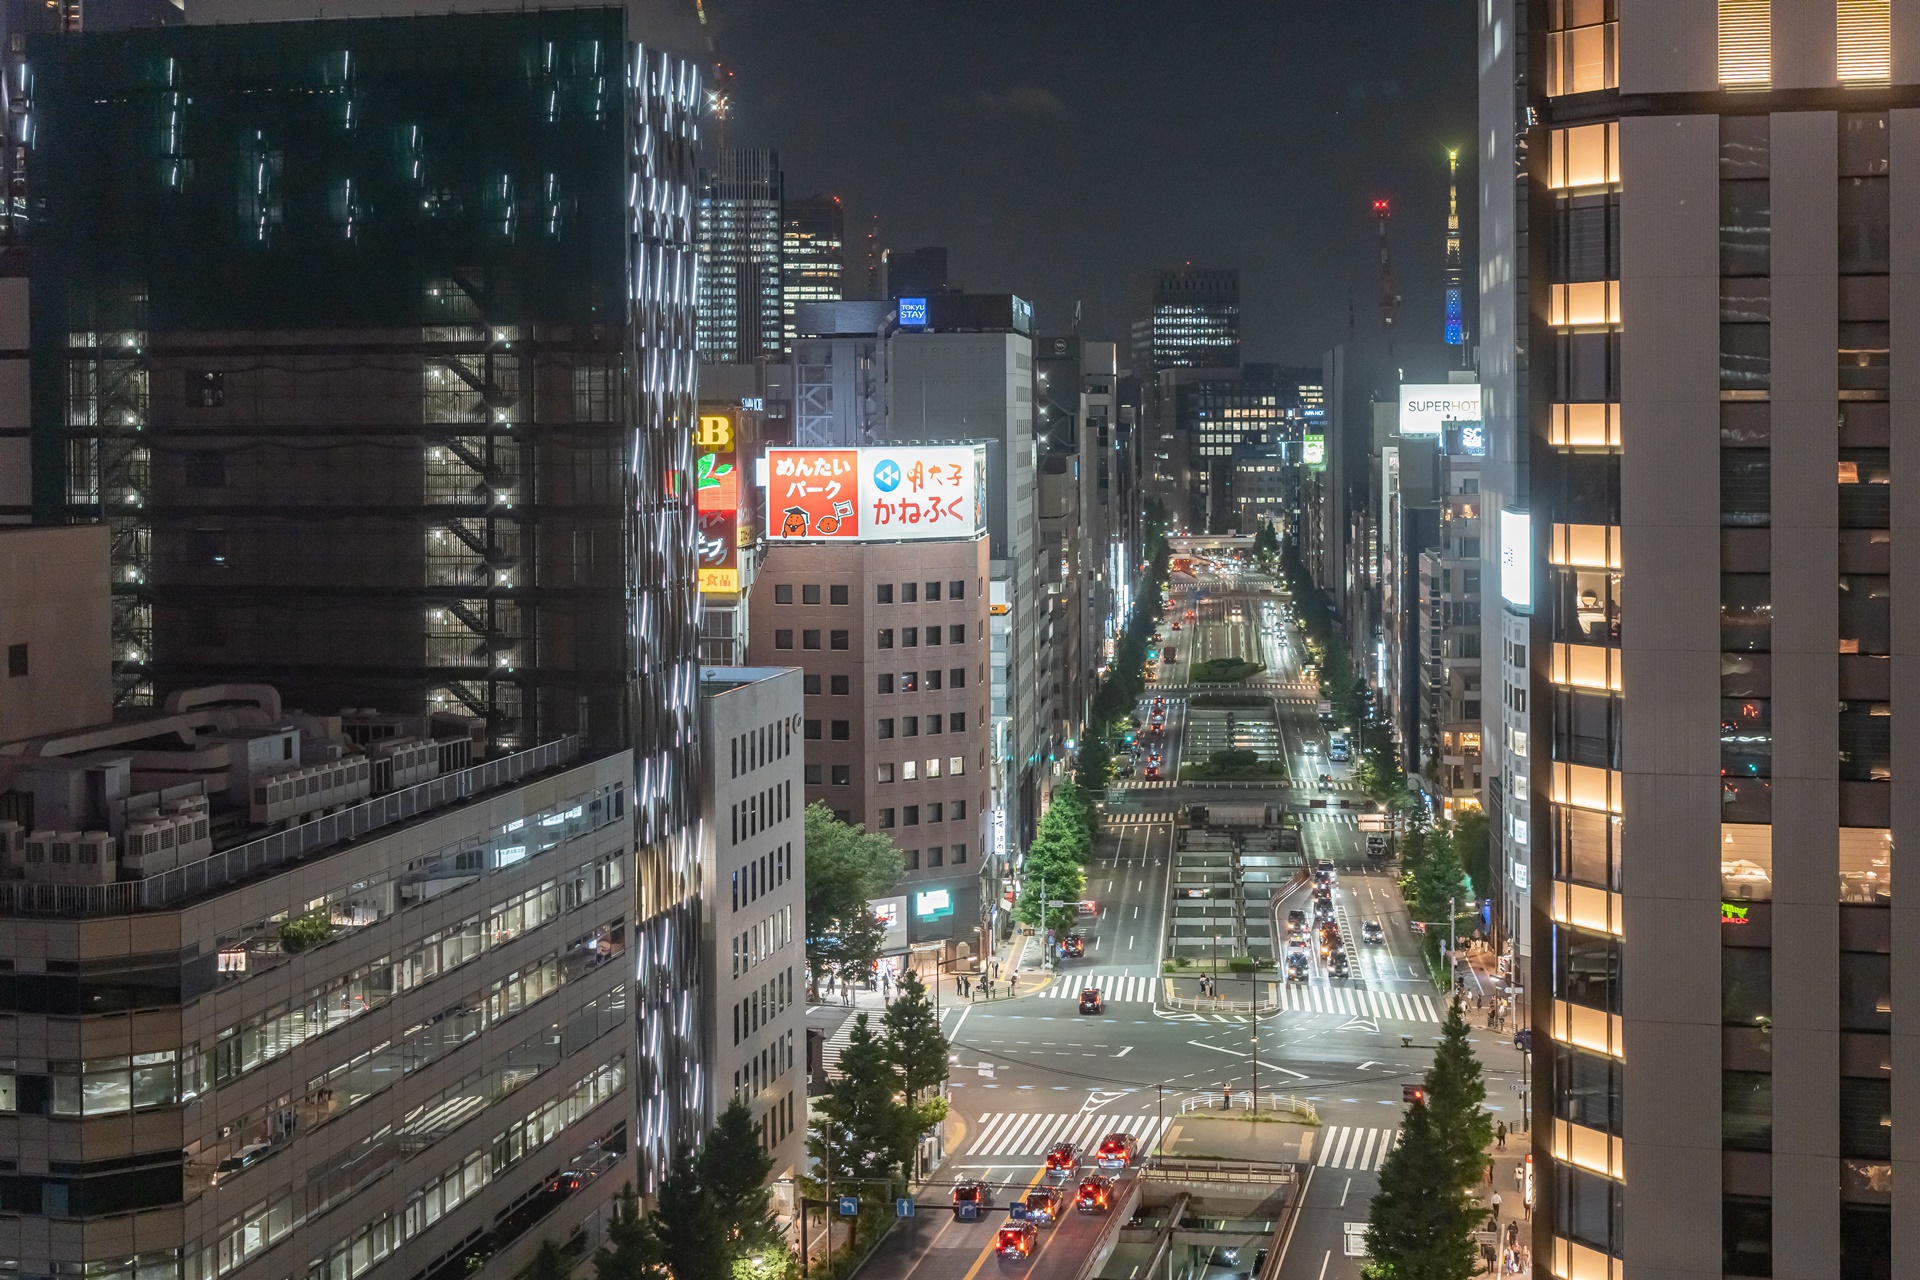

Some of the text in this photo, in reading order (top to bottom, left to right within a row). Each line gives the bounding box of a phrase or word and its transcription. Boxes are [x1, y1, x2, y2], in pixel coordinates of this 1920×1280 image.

[901, 311, 925, 319] STAY
[776, 457, 851, 477] めんたい
[906, 460, 963, 493] 明太子
[786, 479, 842, 500] パーク
[873, 495, 964, 525] かねふく
